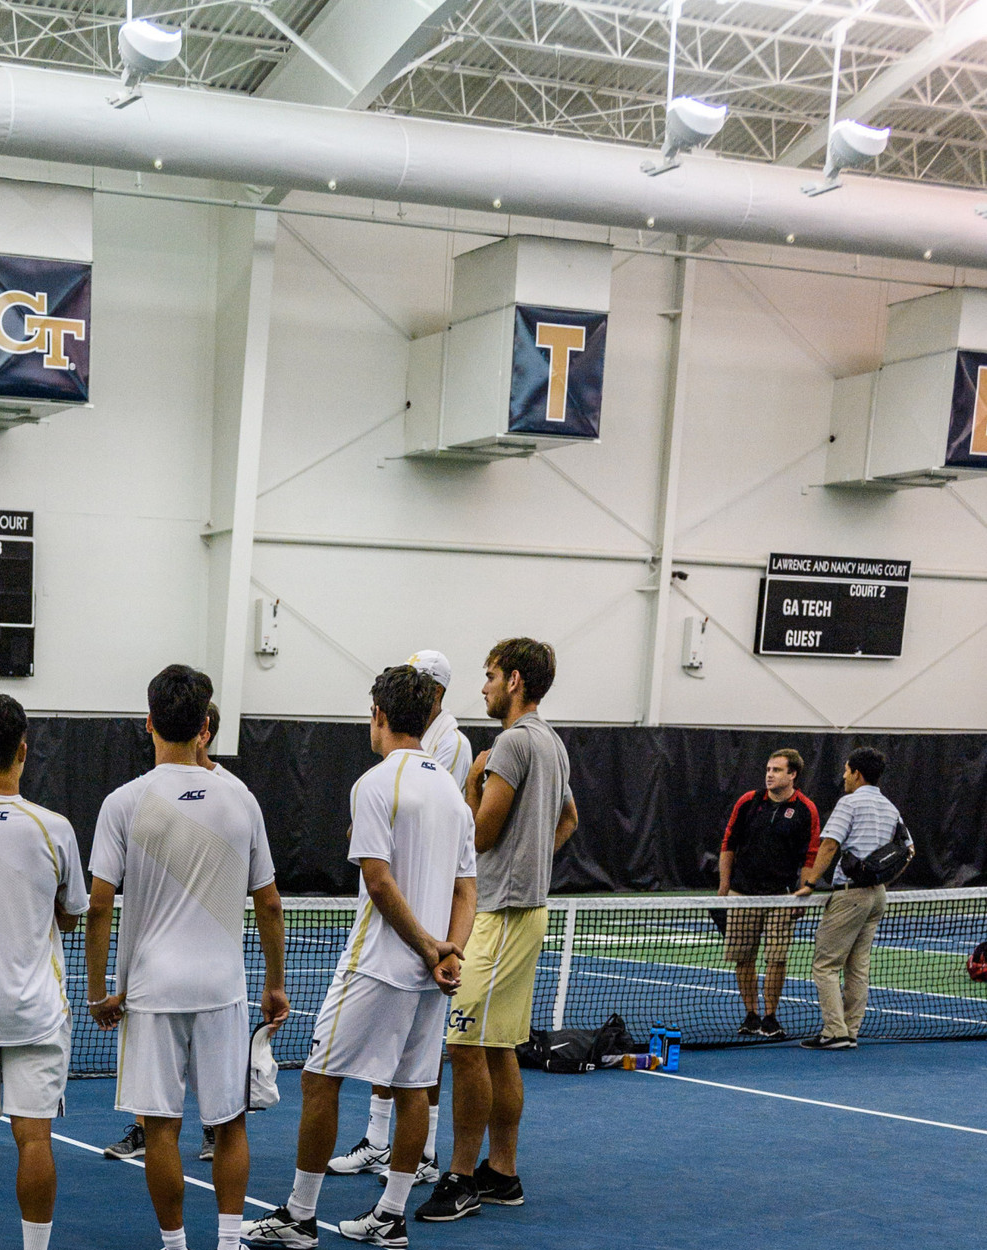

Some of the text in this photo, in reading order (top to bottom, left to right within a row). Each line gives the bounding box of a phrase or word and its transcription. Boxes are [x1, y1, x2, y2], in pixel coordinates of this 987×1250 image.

[535, 322, 587, 422] T
[772, 557, 908, 577] LAWRENCE AND NANCY HUANG COURT
[849, 584, 886, 598] COURT 2
[783, 598, 832, 617] GA TECH
[785, 630, 822, 647] GUEST
[177, 789, 207, 800] ACC
[448, 1009, 476, 1033] GT
